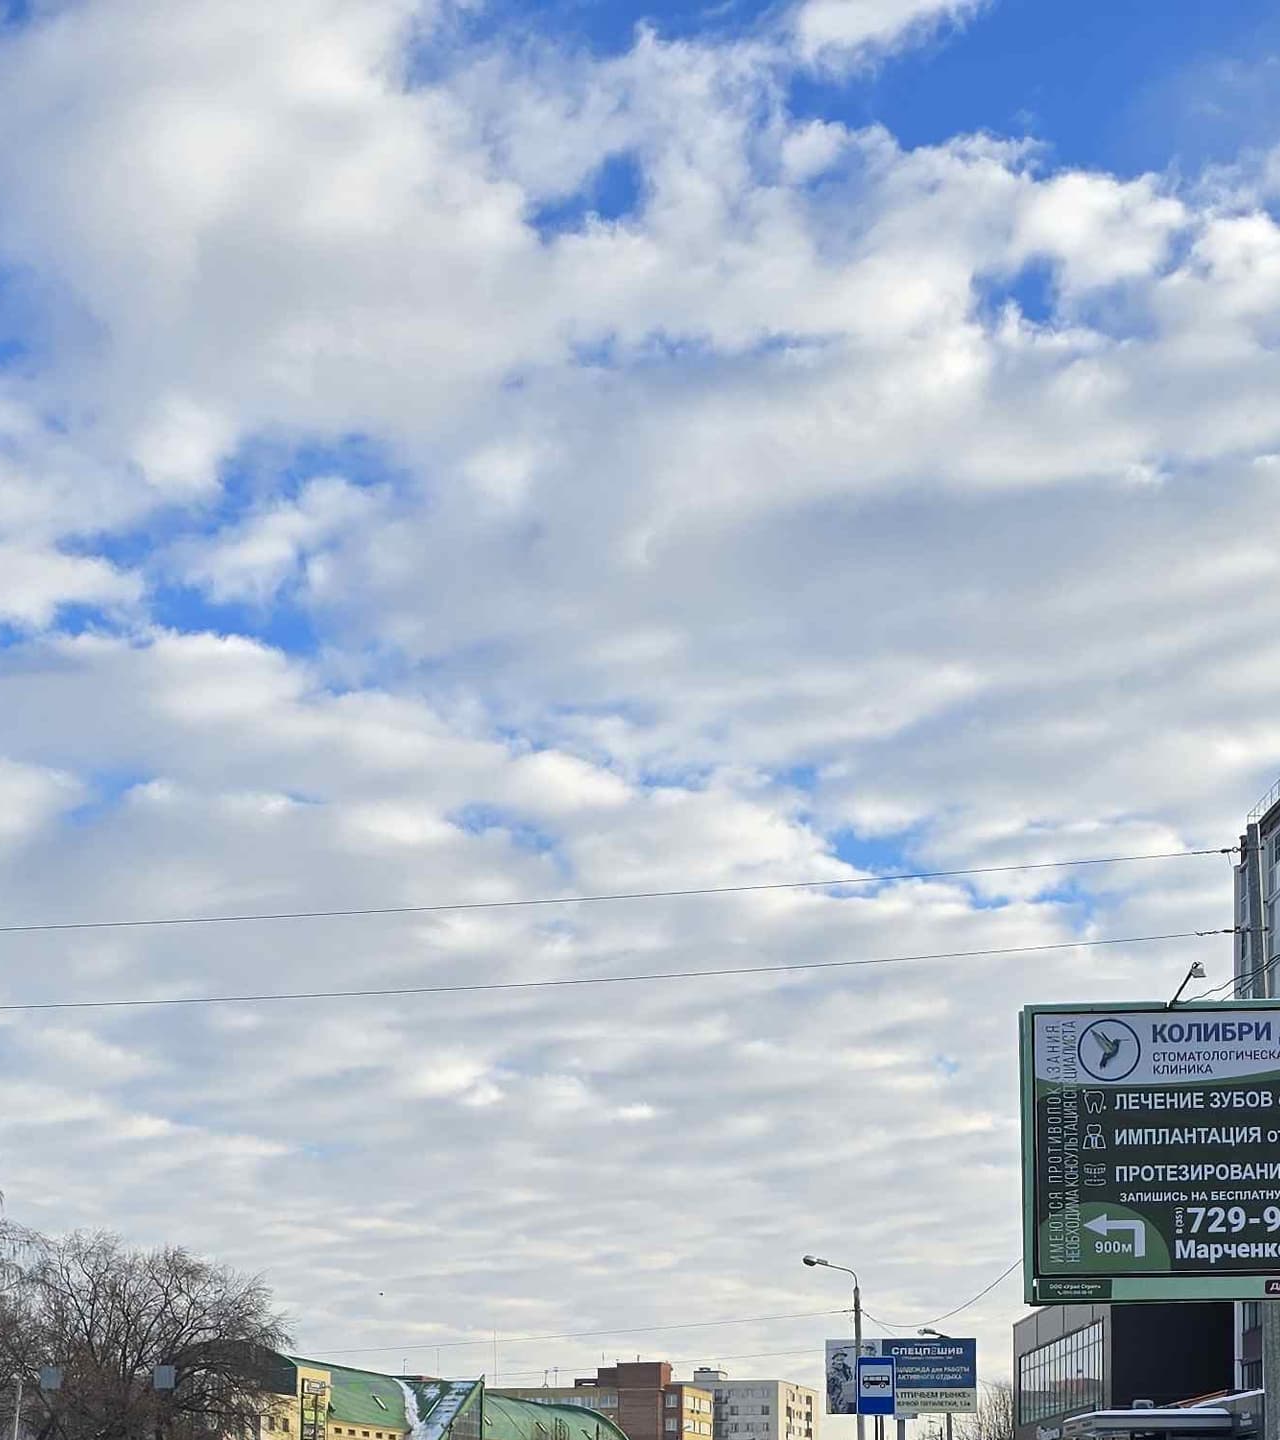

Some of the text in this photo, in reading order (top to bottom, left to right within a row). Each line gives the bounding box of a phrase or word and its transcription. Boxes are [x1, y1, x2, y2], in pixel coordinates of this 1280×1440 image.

[1152, 1022, 1272, 1044] КОЛИБРИ
[1153, 1064, 1213, 1075] КЛИНИКА
[1114, 1092, 1204, 1110] ЛЕЧЕНИЕ
[1209, 1091, 1273, 1109] ЗУБОВ
[1062, 1020, 1080, 1263] НЕОБХОДИМА КОНСУЛЬТАЦИЯ СПЦИАЛИСТА
[1114, 1126, 1261, 1146] ИМПЛАНТАЦИЯ
[1120, 1191, 1188, 1202] ЗАПИШИСЬ
[1191, 1191, 1208, 1201] НА
[1048, 1192, 1064, 1263] ИМЕЮТСЯ
